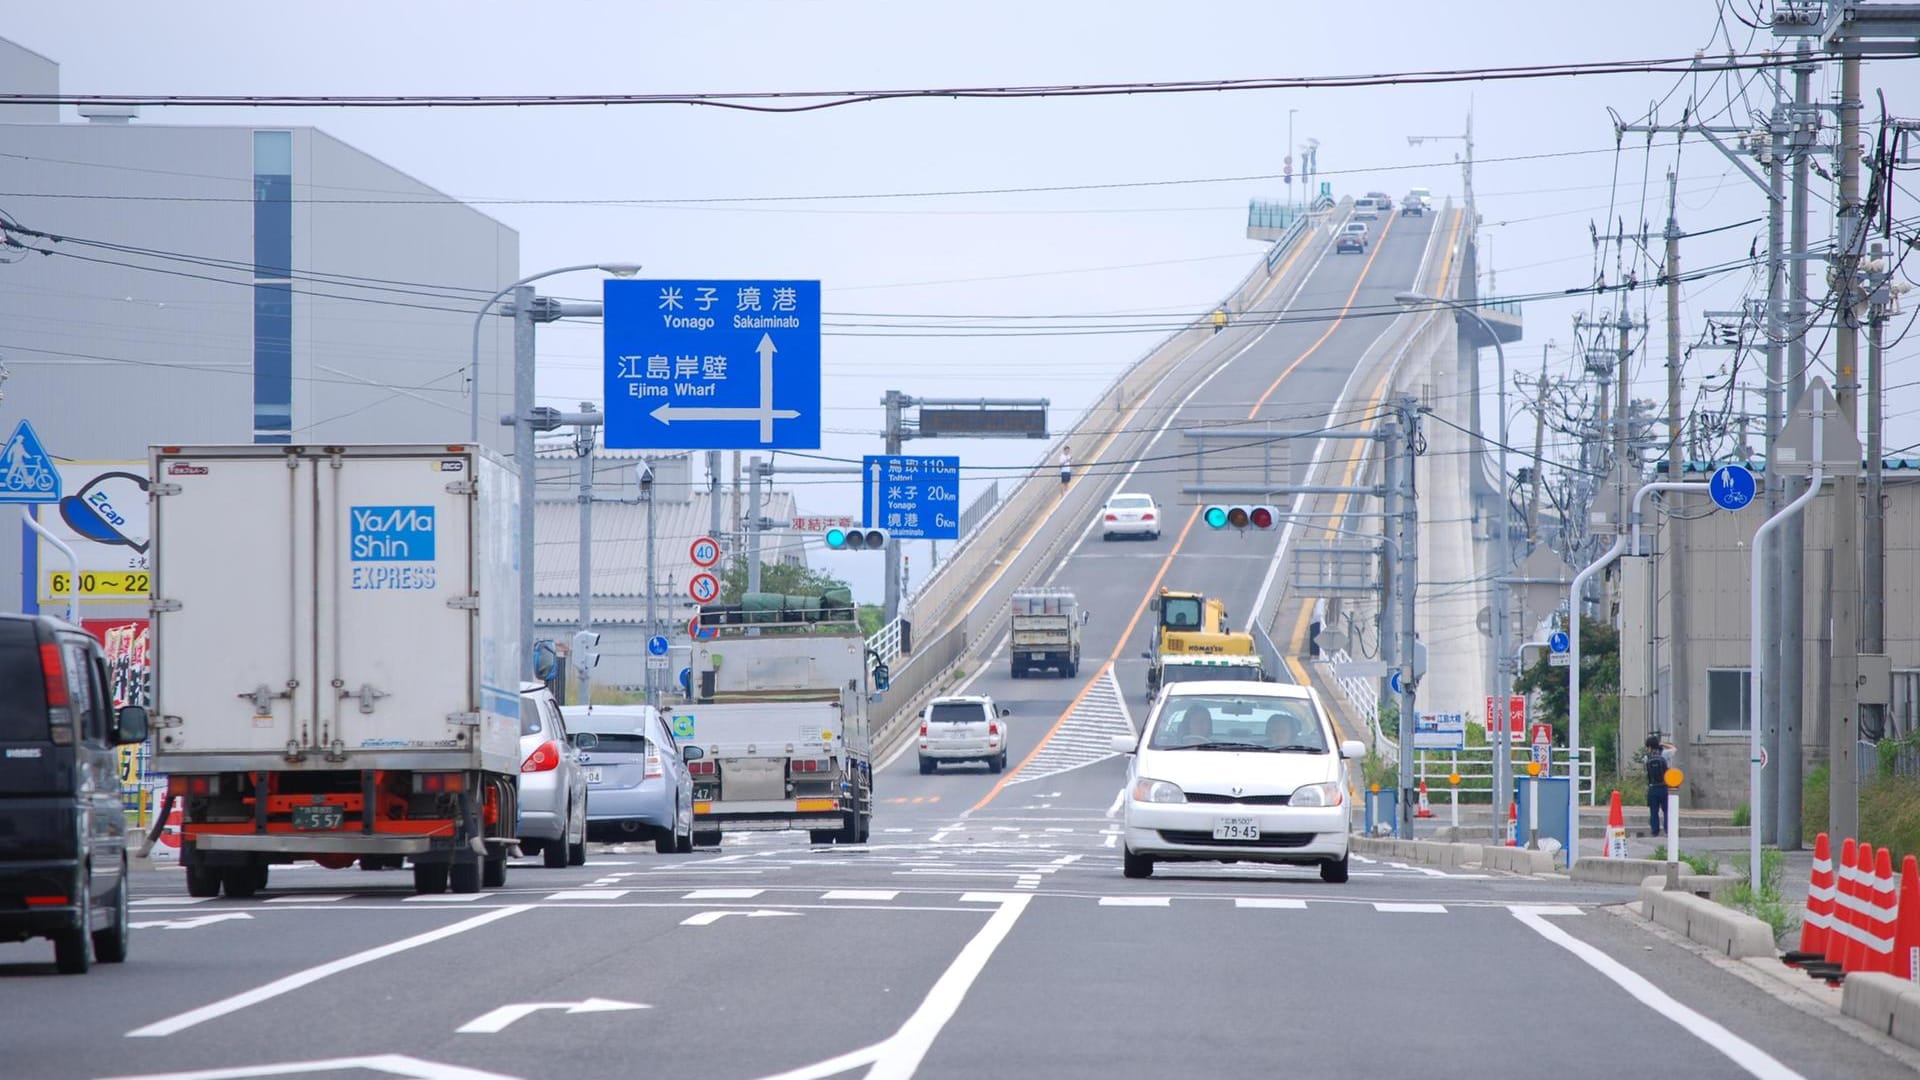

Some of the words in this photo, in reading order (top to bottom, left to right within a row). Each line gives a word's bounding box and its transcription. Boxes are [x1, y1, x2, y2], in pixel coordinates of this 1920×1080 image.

[659, 286, 719, 311] 米子
[736, 286, 797, 311] 境港
[663, 315, 715, 330] Yonago
[733, 314, 799, 328] Sakaiminato
[617, 354, 727, 380] 江島岸壁
[629, 383, 668, 399] Ejima
[674, 383, 716, 396] Wharf
[888, 486, 918, 500] 米子
[888, 502, 917, 511] Yonago
[888, 513, 918, 527] 境港
[354, 534, 409, 557] Shin
[697, 546, 713, 559] 40
[352, 566, 436, 590] EXPRESS
